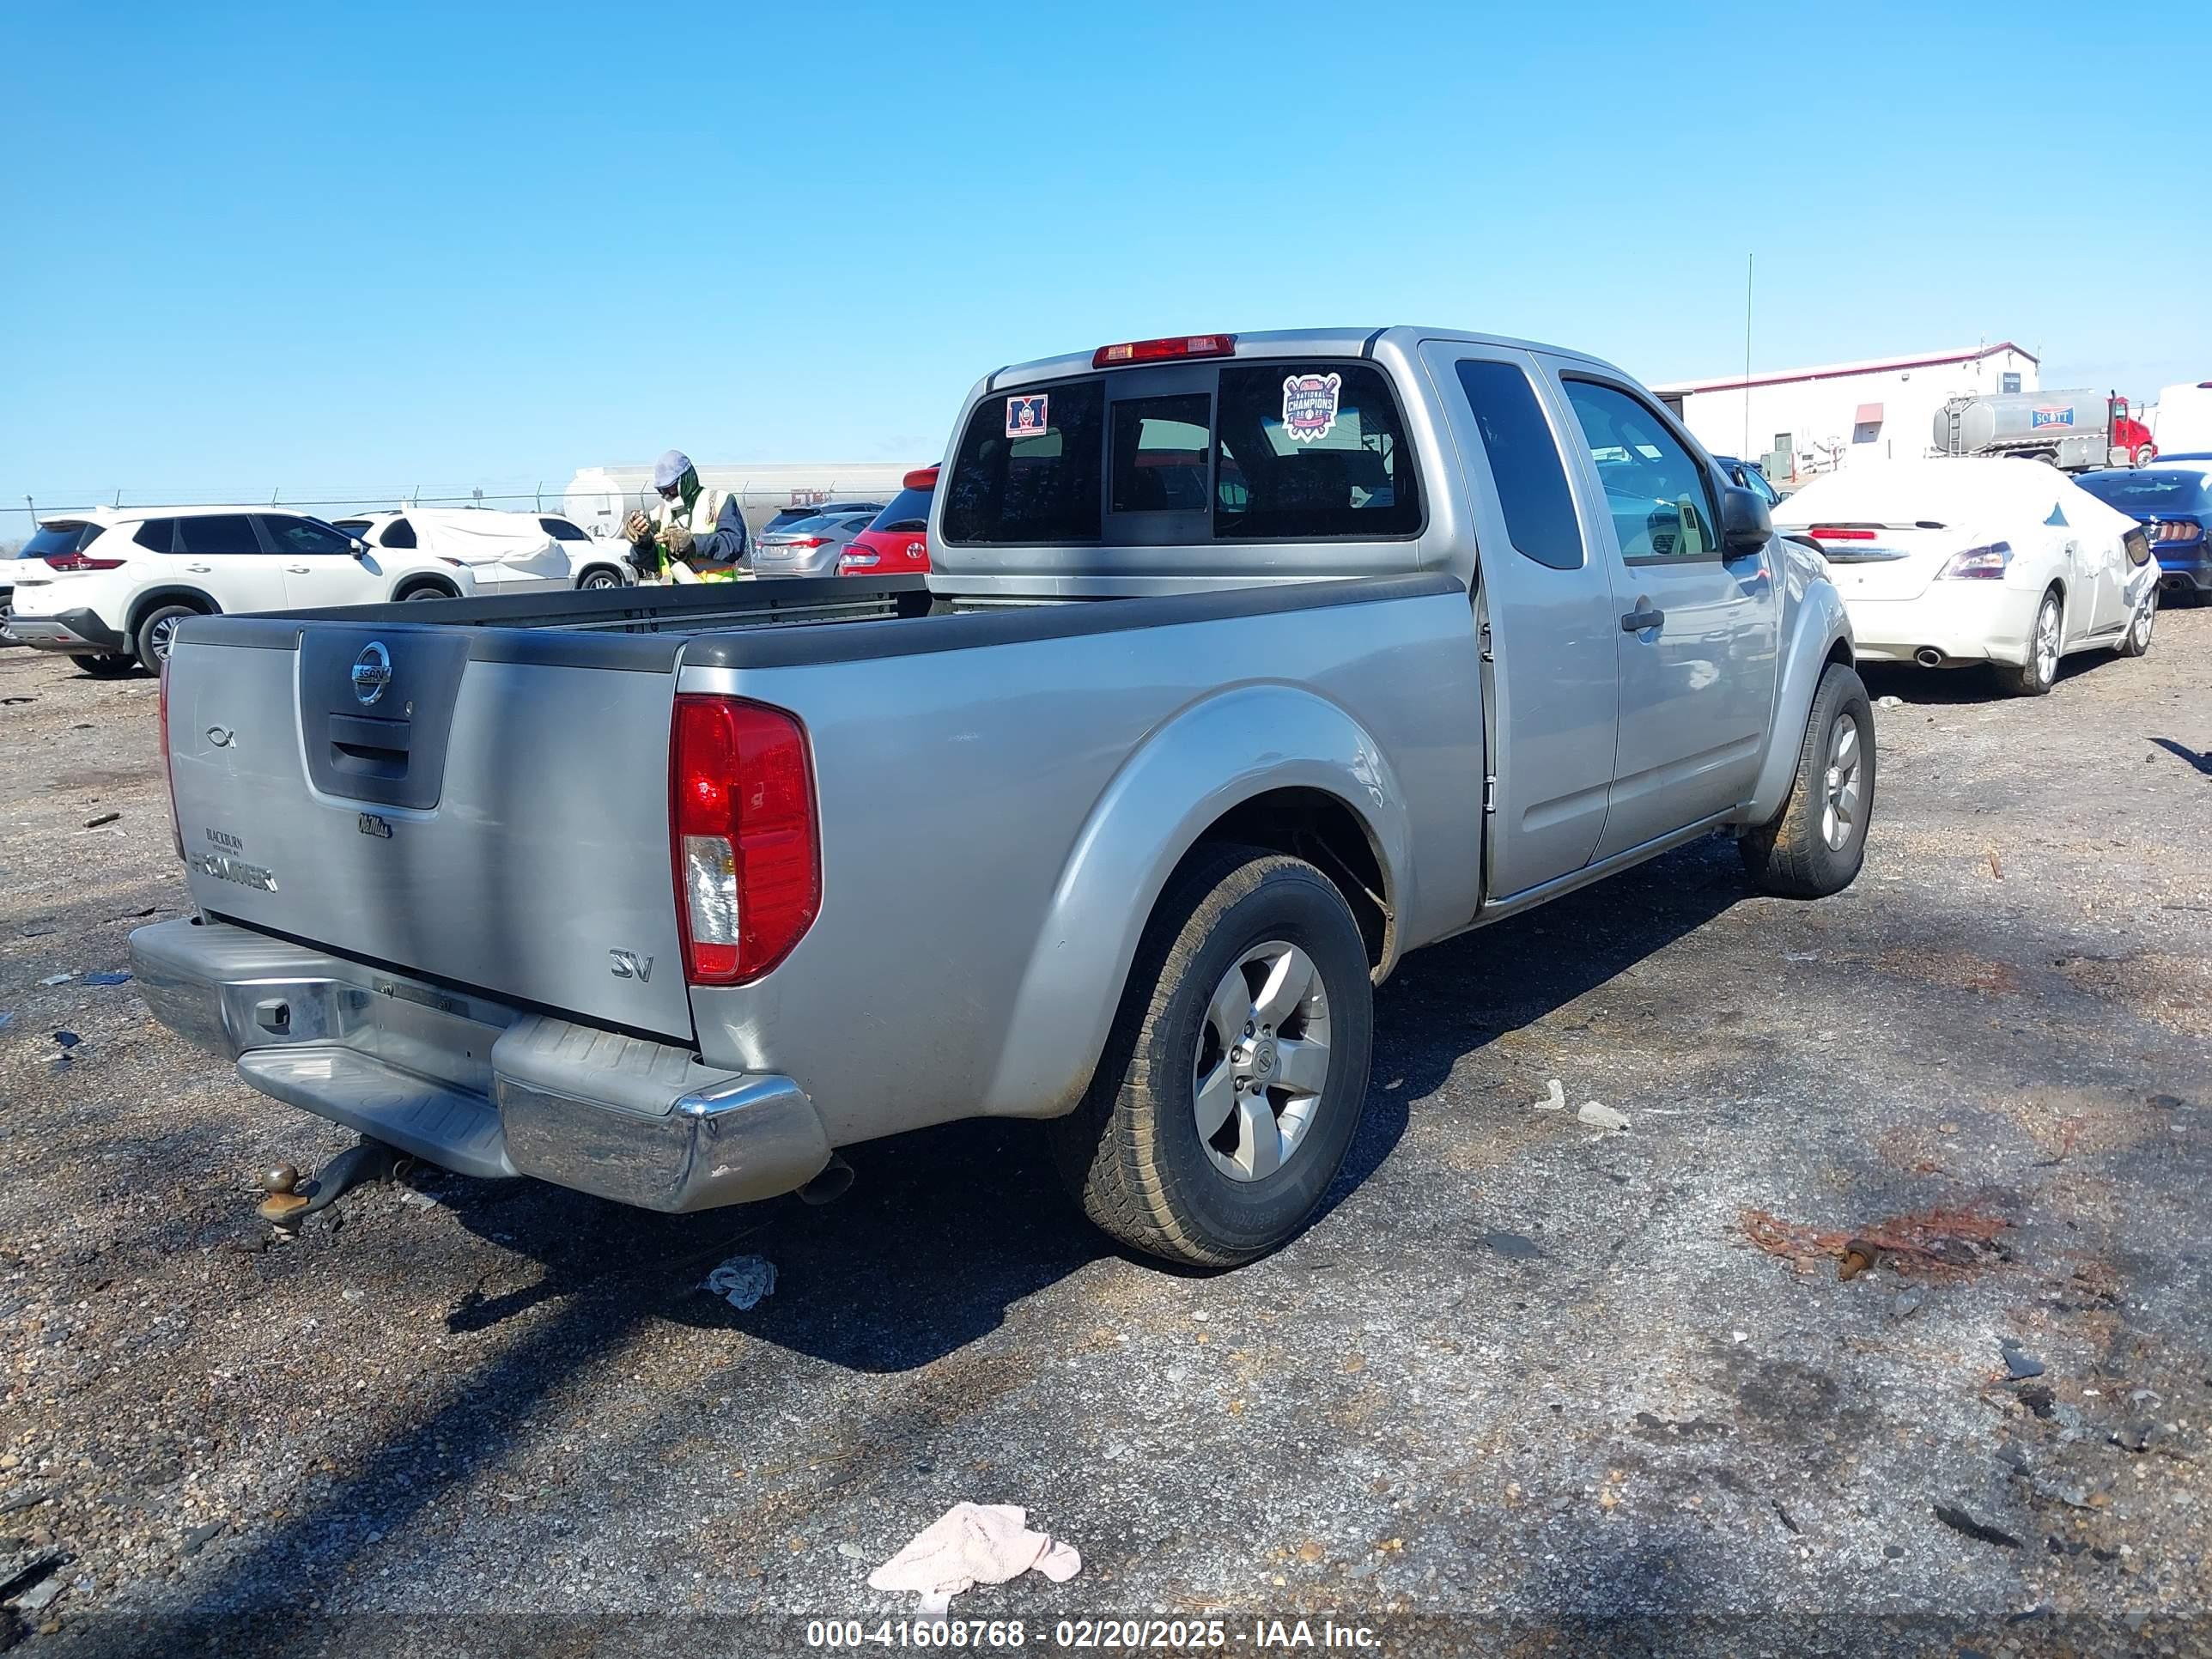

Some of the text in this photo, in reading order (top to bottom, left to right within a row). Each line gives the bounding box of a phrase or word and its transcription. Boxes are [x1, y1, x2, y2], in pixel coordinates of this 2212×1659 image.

[1288, 398, 1333, 412] CHAMPIONS
[353, 667, 385, 680] NISSAN
[206, 827, 243, 851] BLACKBURN
[609, 947, 654, 983] SV
